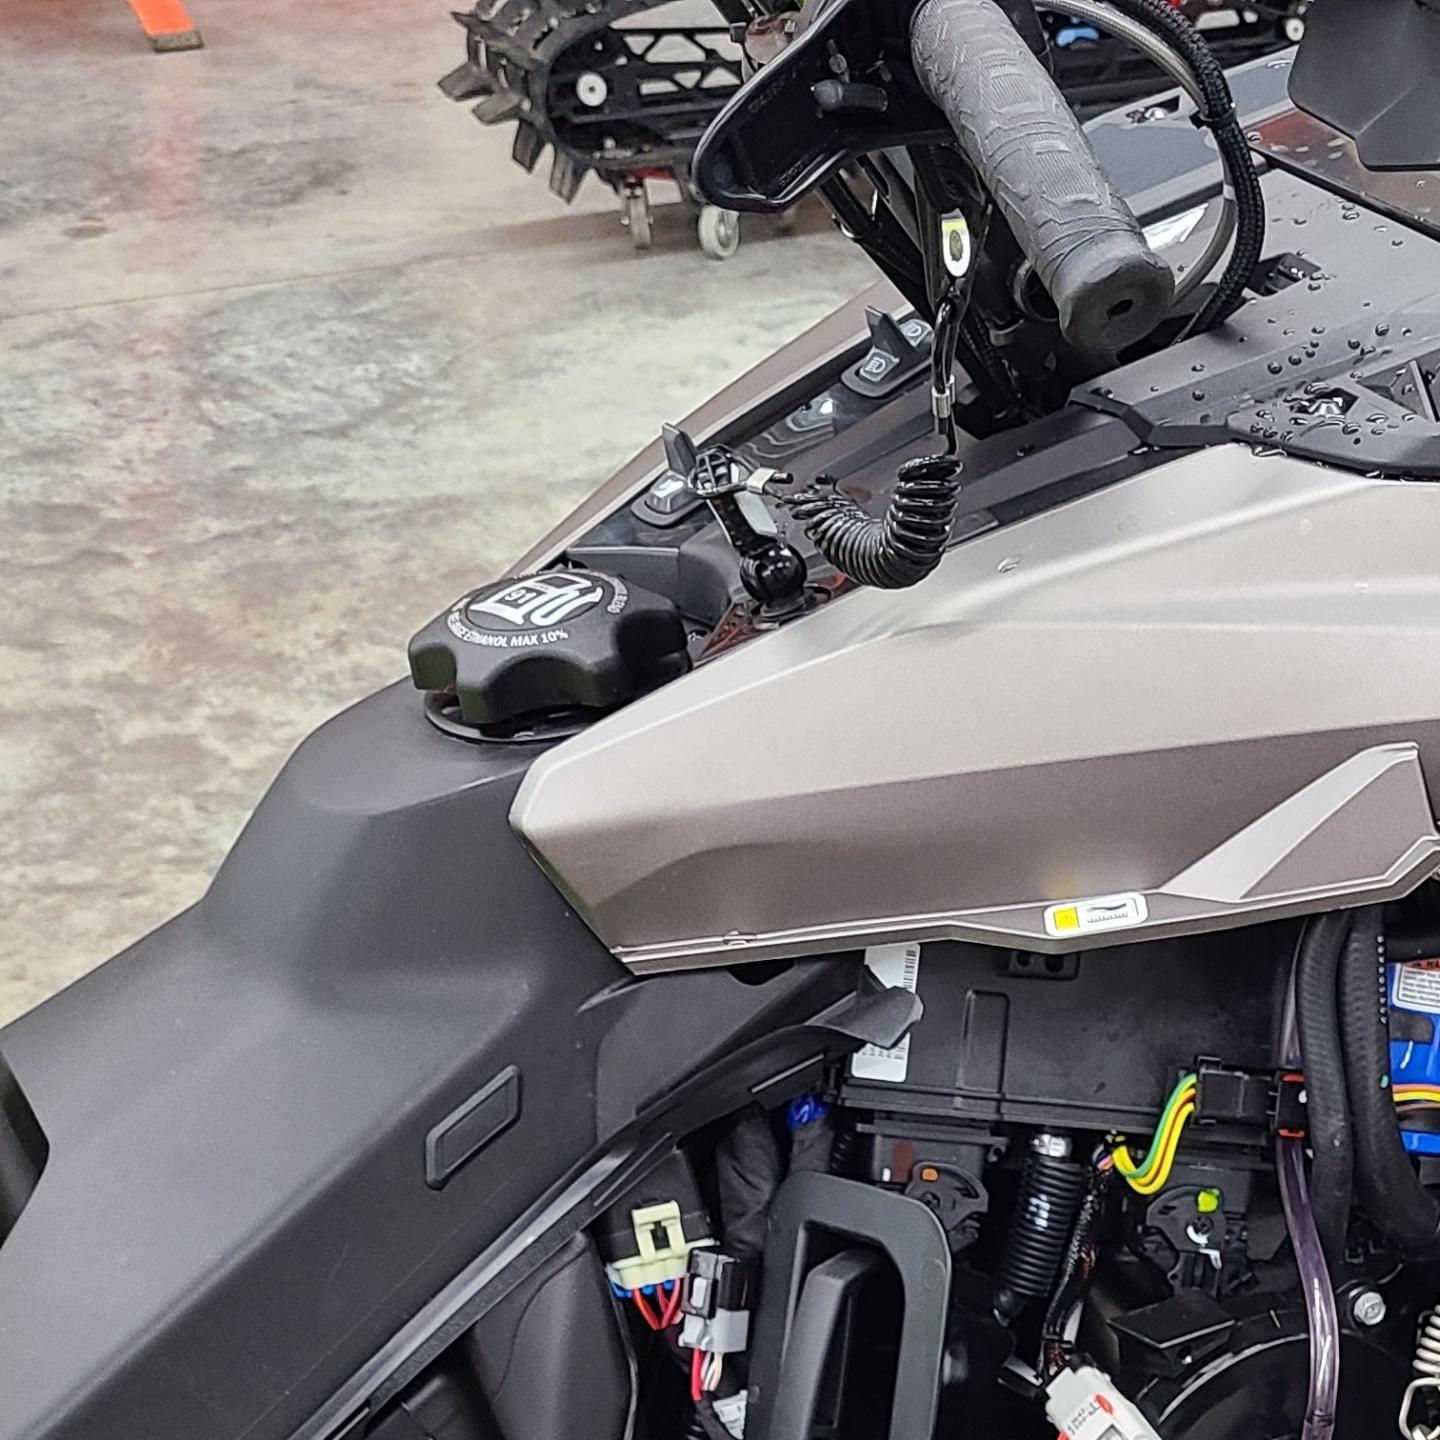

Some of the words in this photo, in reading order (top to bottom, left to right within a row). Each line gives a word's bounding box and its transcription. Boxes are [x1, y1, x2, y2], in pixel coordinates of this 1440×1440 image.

[504, 588, 537, 604] 91
[510, 633, 539, 648] MAX
[541, 627, 569, 645] 10%
